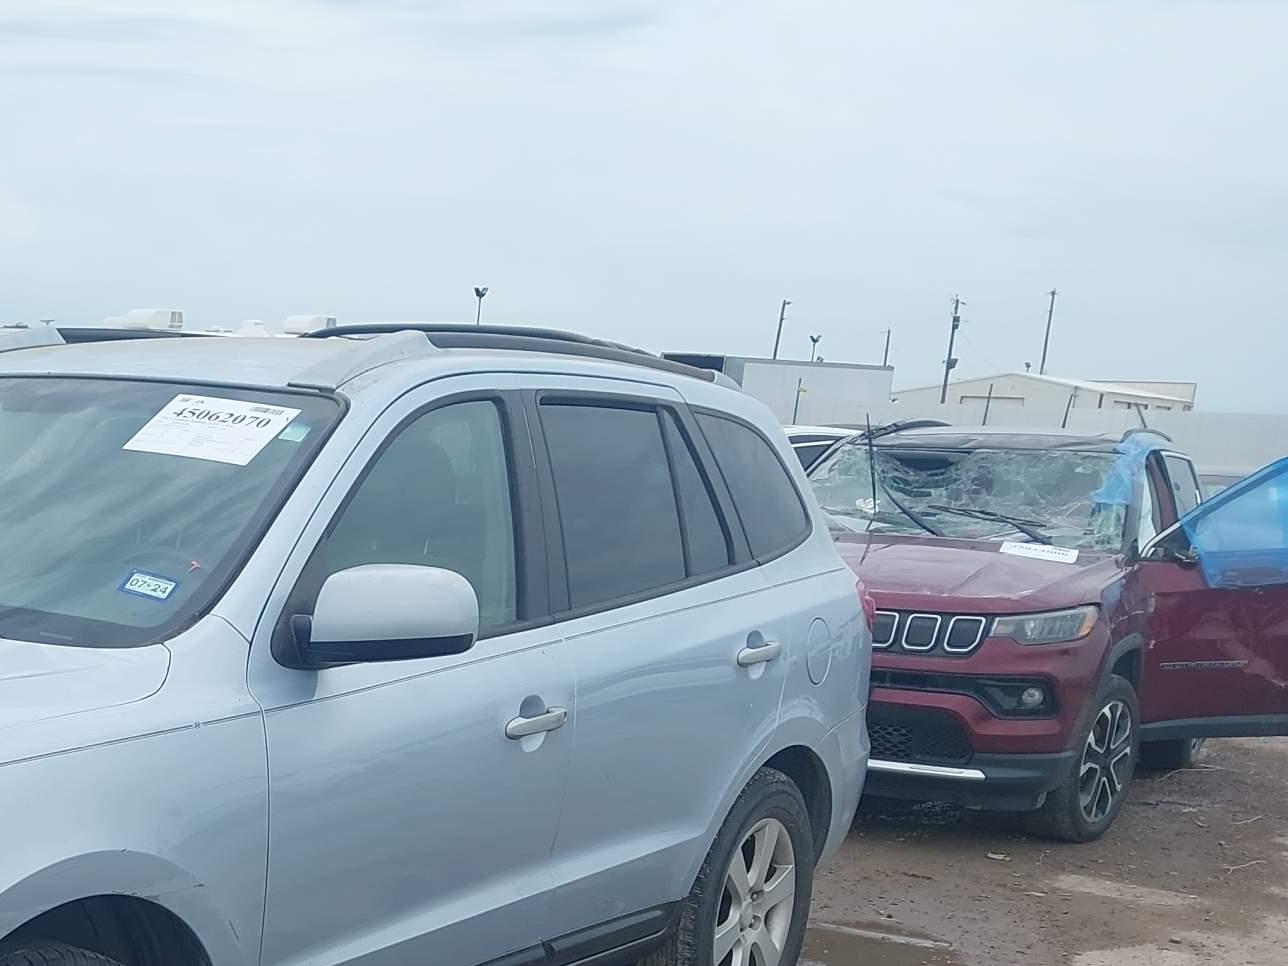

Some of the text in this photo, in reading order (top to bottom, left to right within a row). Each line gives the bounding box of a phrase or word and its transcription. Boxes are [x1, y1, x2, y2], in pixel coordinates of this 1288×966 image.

[173, 406, 272, 429] 45062070
[129, 578, 148, 588] 07
[150, 583, 169, 595] 24
